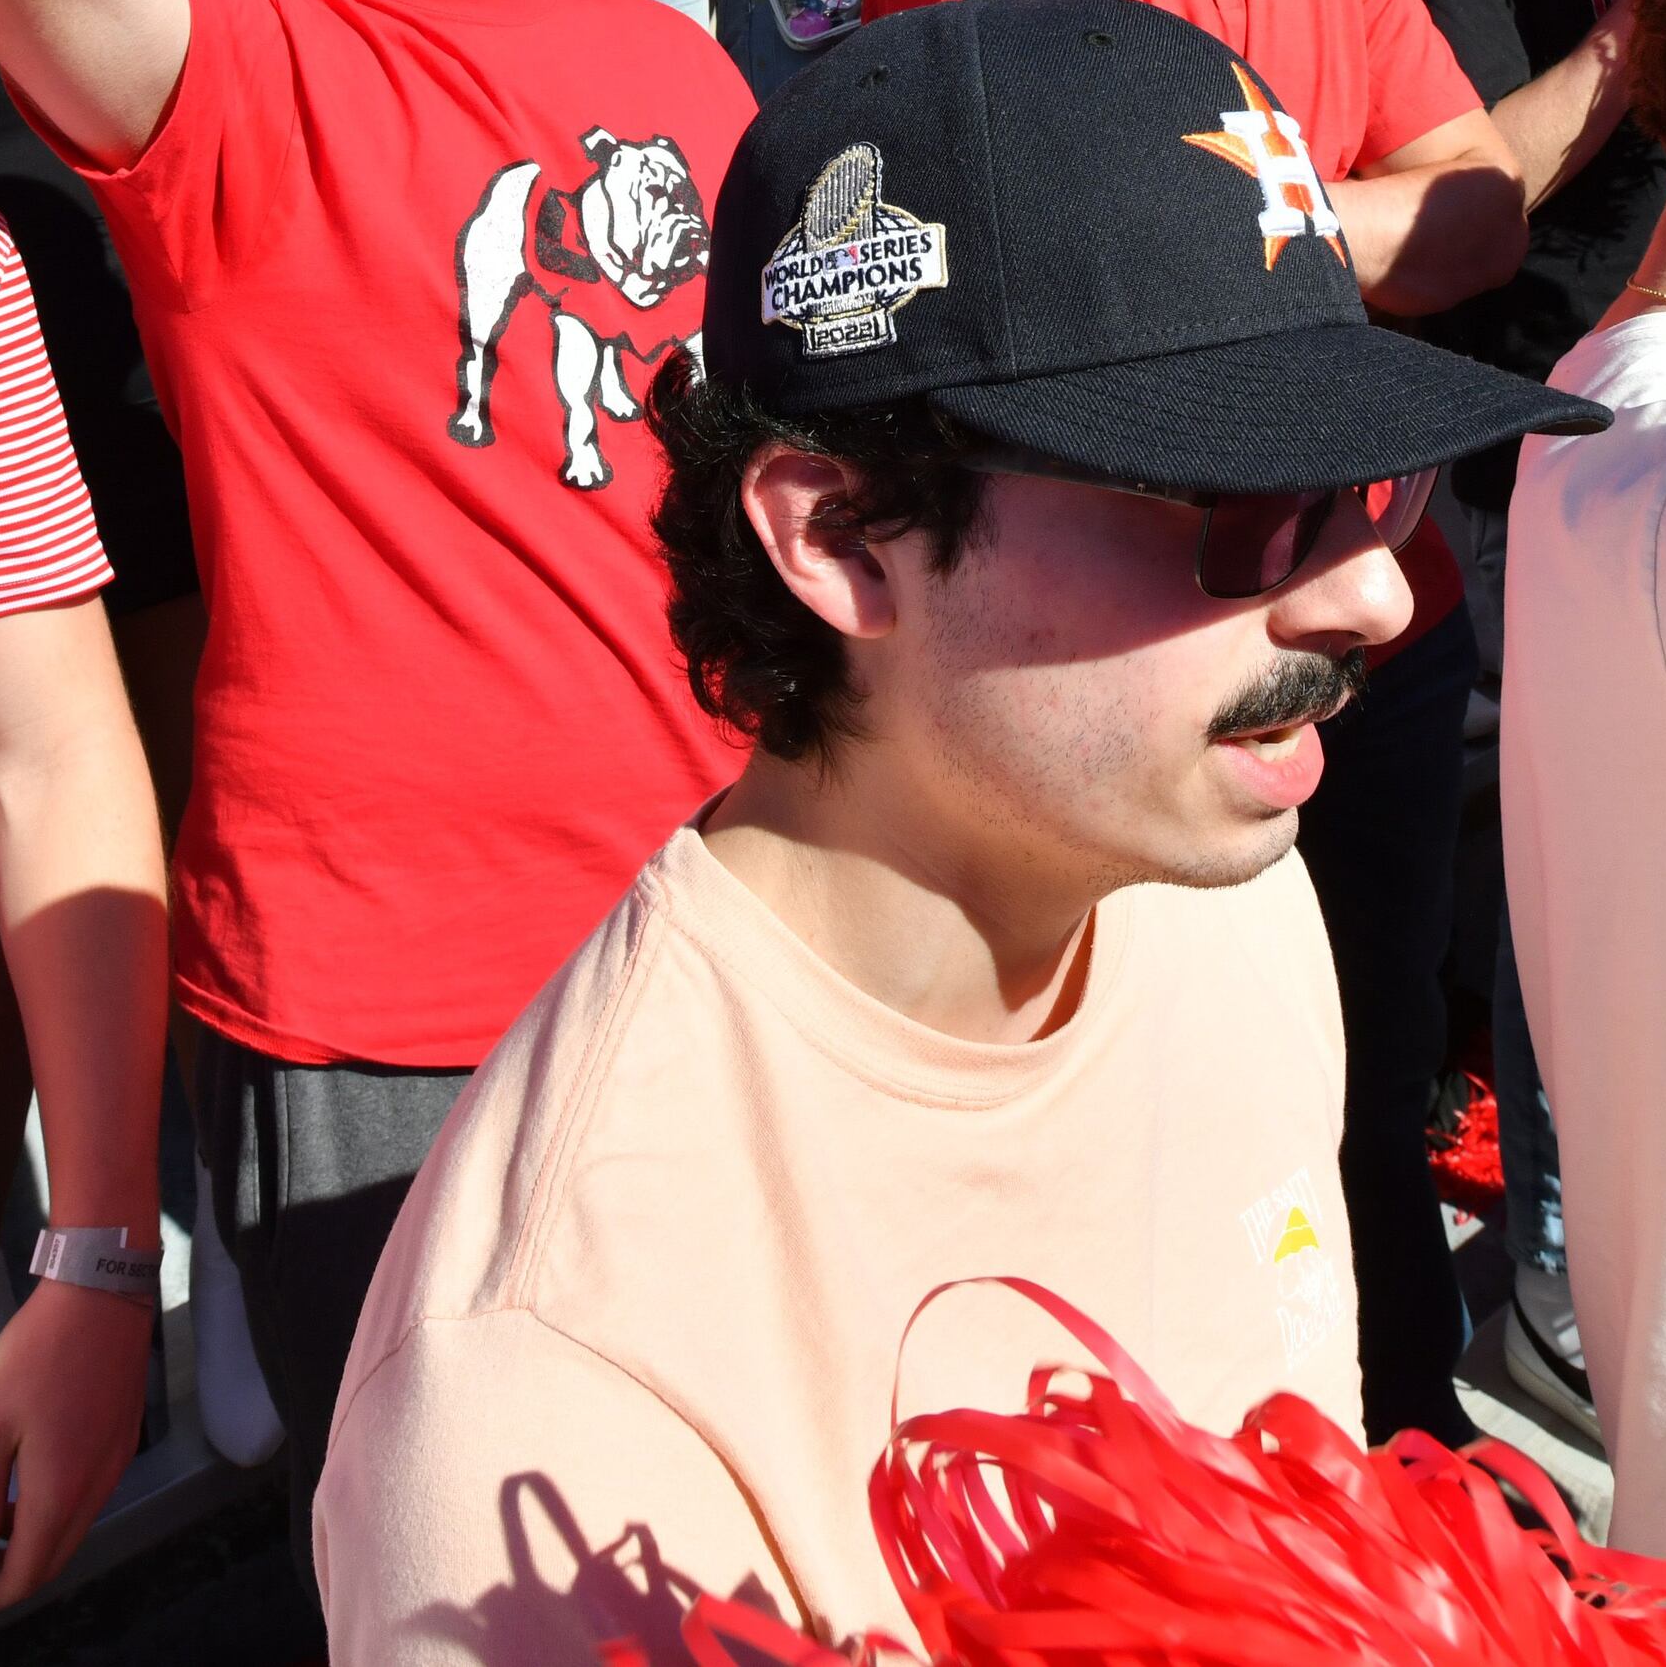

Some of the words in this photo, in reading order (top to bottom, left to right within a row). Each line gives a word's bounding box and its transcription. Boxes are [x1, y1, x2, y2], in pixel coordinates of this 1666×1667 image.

[1221, 110, 1339, 237] H
[765, 256, 823, 290] WORLD
[859, 231, 933, 265] SERIES
[772, 257, 923, 310] CHAMPIONS
[95, 1257, 127, 1275] FOR
